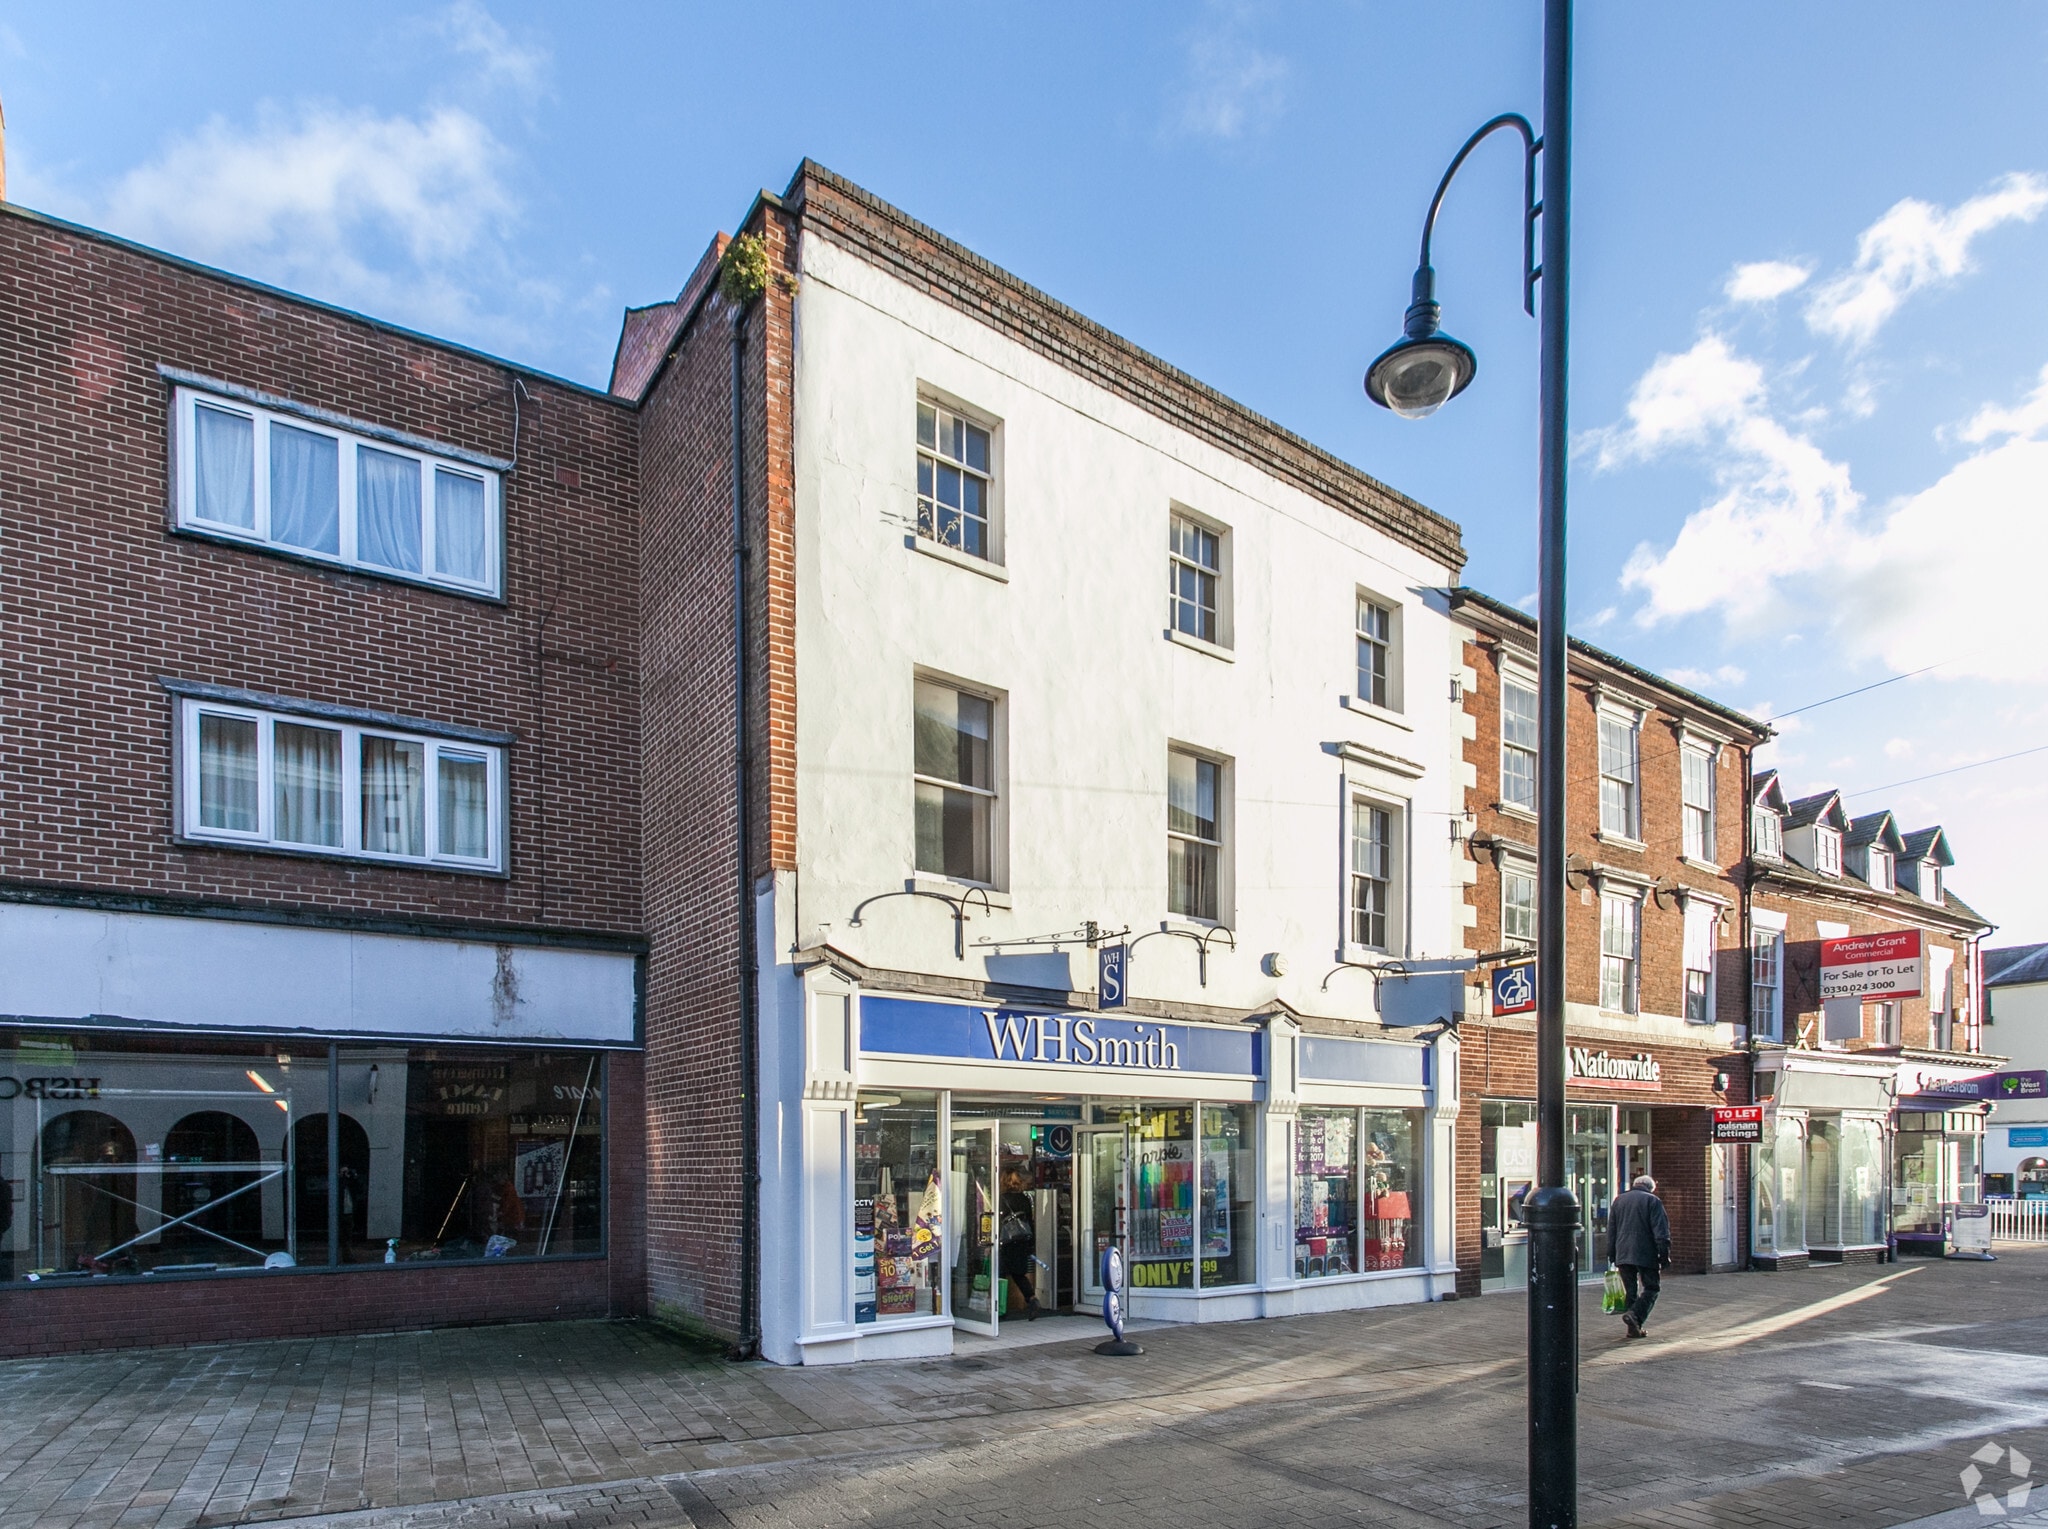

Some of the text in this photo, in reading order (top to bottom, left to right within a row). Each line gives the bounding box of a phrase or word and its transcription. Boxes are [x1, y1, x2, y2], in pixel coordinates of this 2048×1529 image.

[1833, 936, 1907, 952] Andrew Grant
[1103, 951, 1120, 965] WH
[1845, 948, 1894, 959] Commercial
[1823, 965, 1915, 981] For Sale or To Let
[1103, 964, 1120, 1000] S
[1823, 981, 1895, 993] 0330 024 3000
[981, 1011, 1181, 1070] WHSmith
[1573, 1048, 1660, 1082] Nationwide
[1717, 1109, 1758, 1119] TO LET
[1717, 1121, 1758, 1130] oulsnam
[1717, 1130, 1758, 1138] lettings
[1310, 1153, 1324, 1161] 2017
[1503, 1147, 1533, 1167] CASH
[854, 1199, 874, 1207] CCTV
[1132, 1262, 1182, 1287] ONLY
